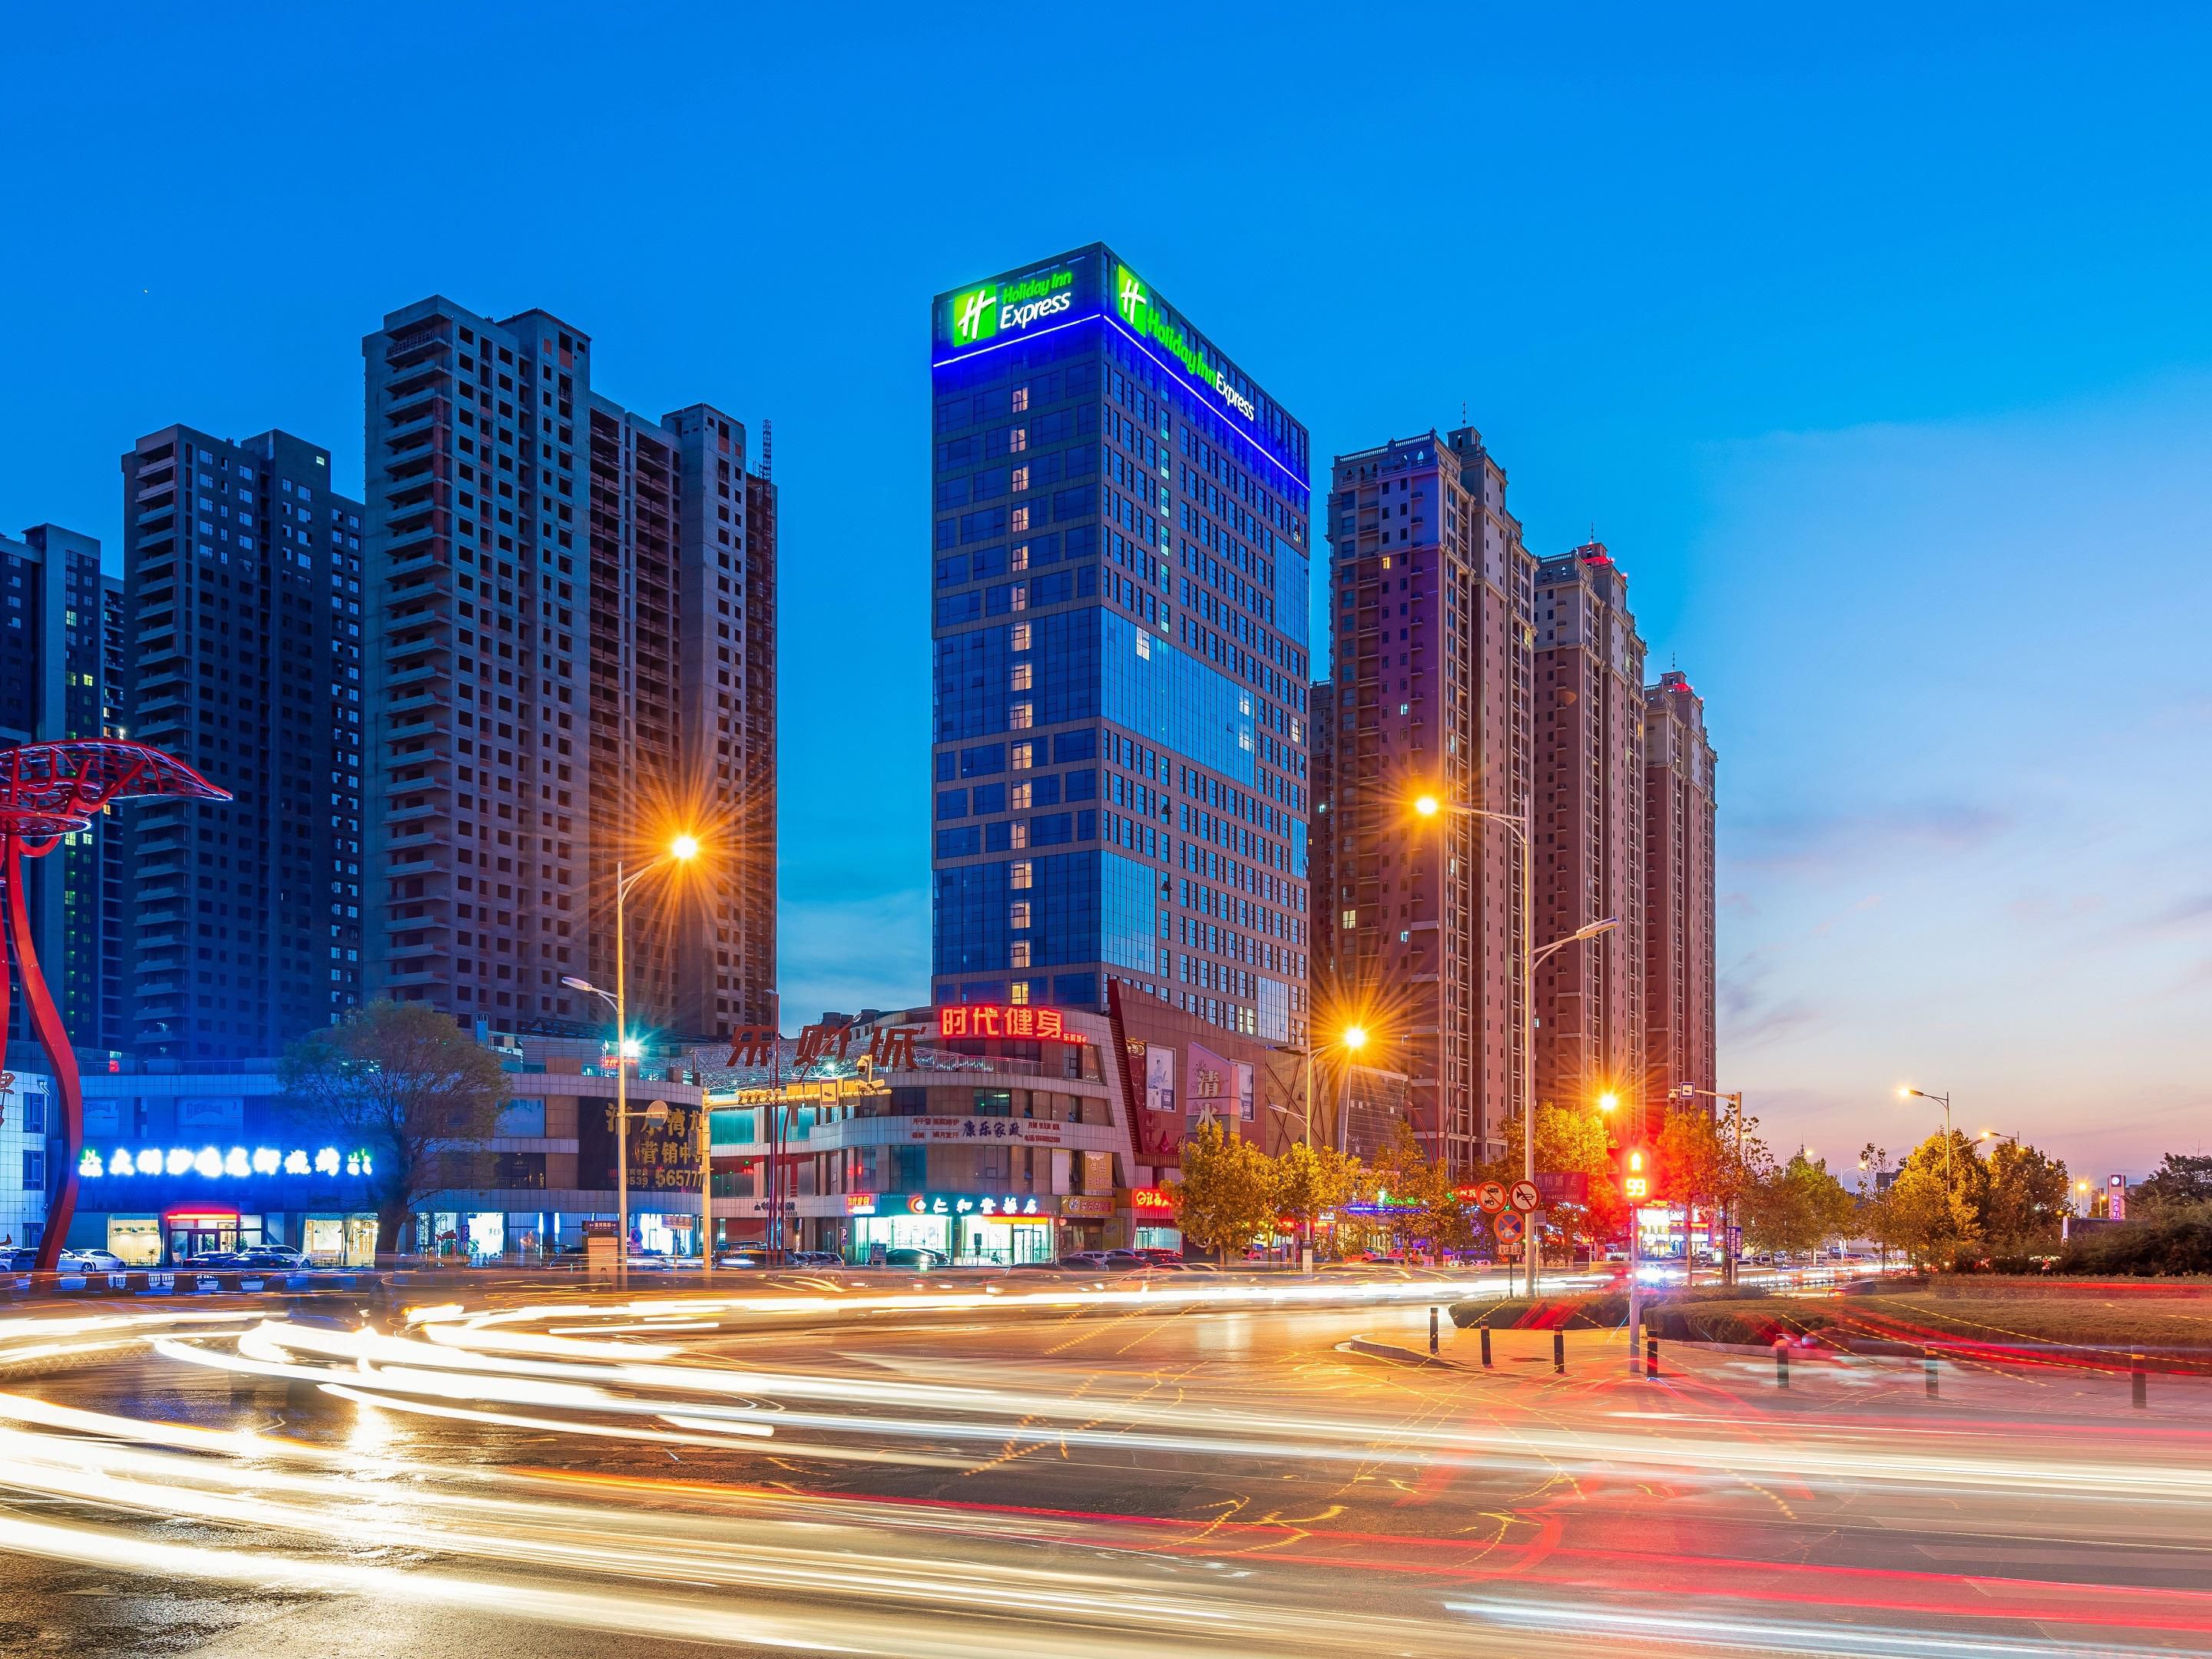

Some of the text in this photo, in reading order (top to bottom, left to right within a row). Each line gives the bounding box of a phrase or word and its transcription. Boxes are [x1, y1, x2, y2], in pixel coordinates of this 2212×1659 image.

[1002, 272, 1072, 304] Holiday Inn
[1000, 292, 1071, 329] Express
[1216, 371, 1254, 422] Express
[942, 1007, 1062, 1038] 时代健身
[726, 1025, 926, 1070] 乐购城
[626, 1177, 648, 1185] 539
[1625, 1177, 1647, 1197] 99
